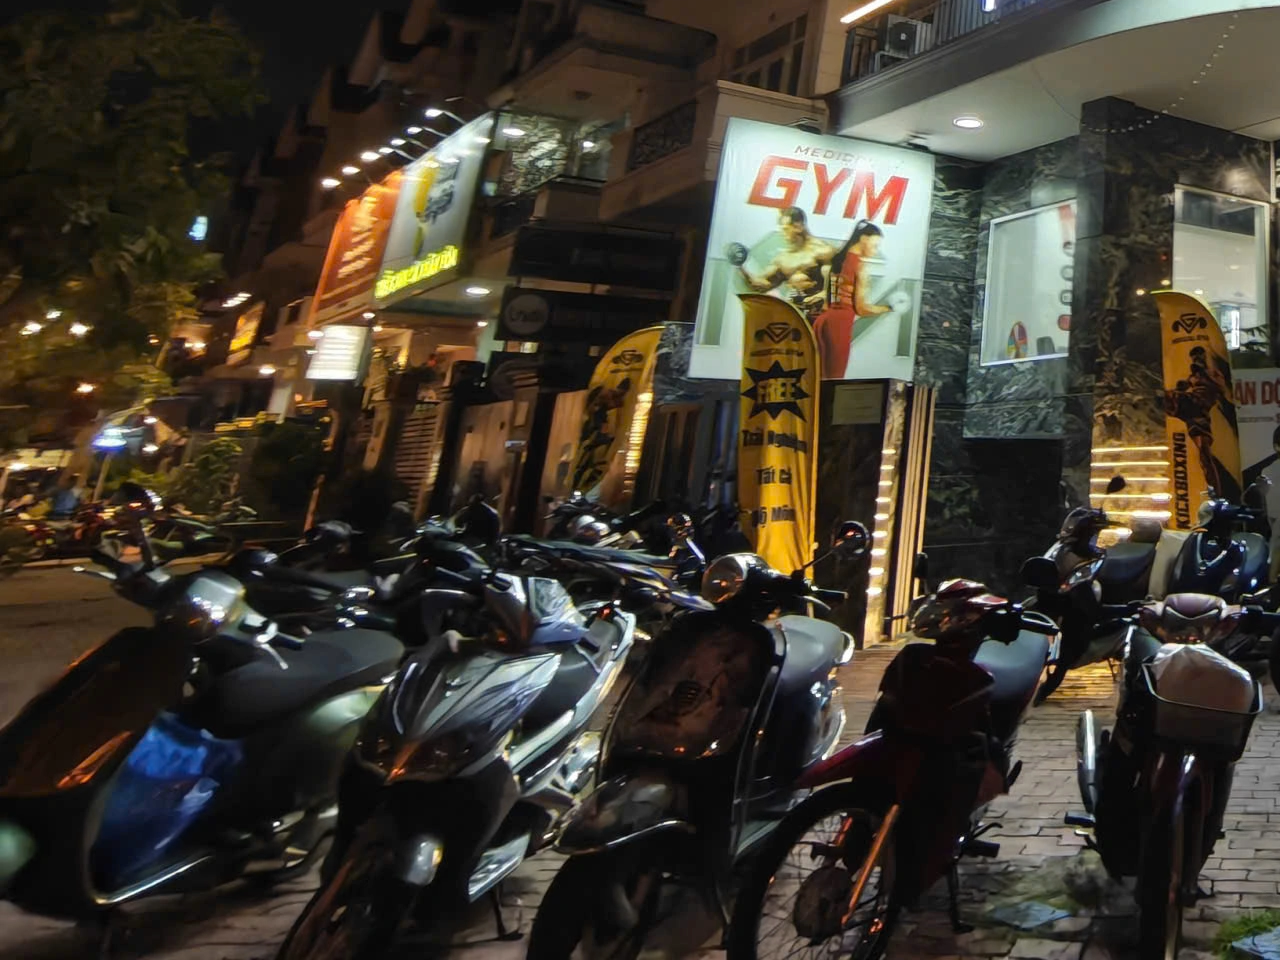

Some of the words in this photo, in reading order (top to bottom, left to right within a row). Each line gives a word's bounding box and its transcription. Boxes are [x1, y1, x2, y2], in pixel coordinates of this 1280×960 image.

[794, 145, 873, 164] MEDIC
[747, 155, 909, 225] GYM
[1172, 432, 1191, 530] KICKBOXING
